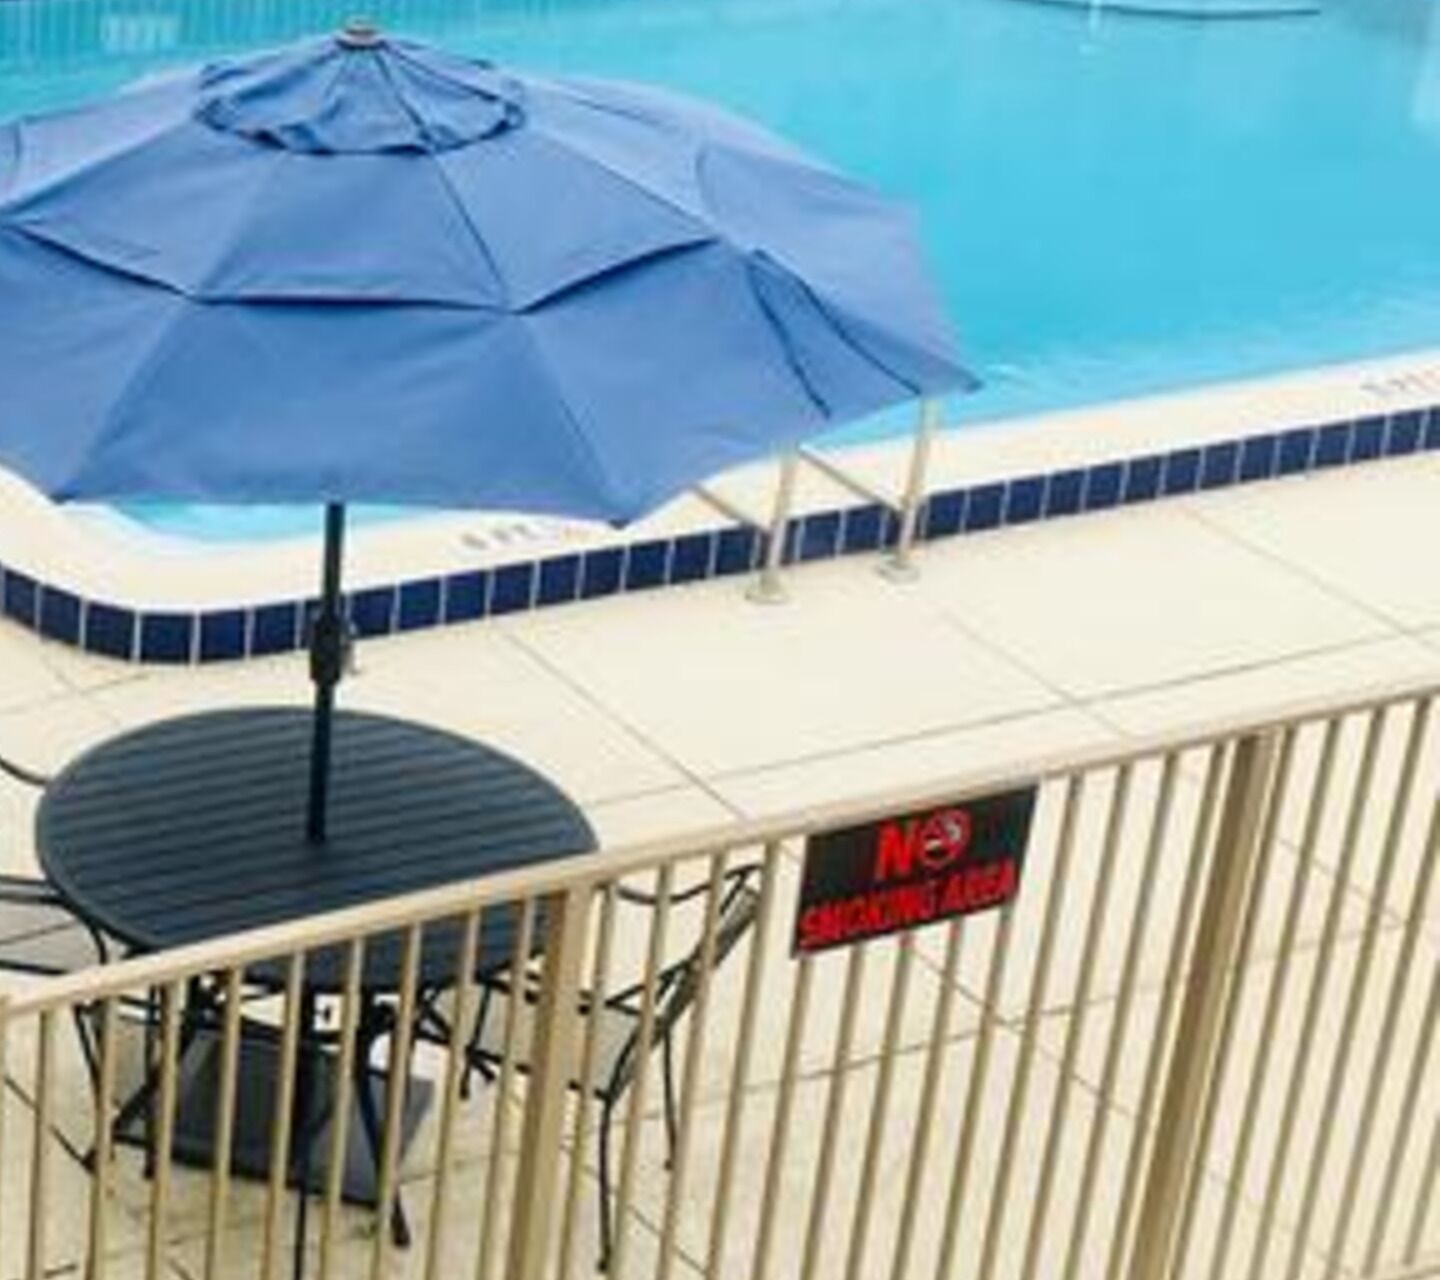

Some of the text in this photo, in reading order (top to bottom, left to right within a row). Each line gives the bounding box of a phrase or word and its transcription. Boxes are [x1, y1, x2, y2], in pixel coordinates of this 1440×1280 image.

[877, 807, 972, 880] NO
[798, 858, 1017, 952] SMOKING AREA
